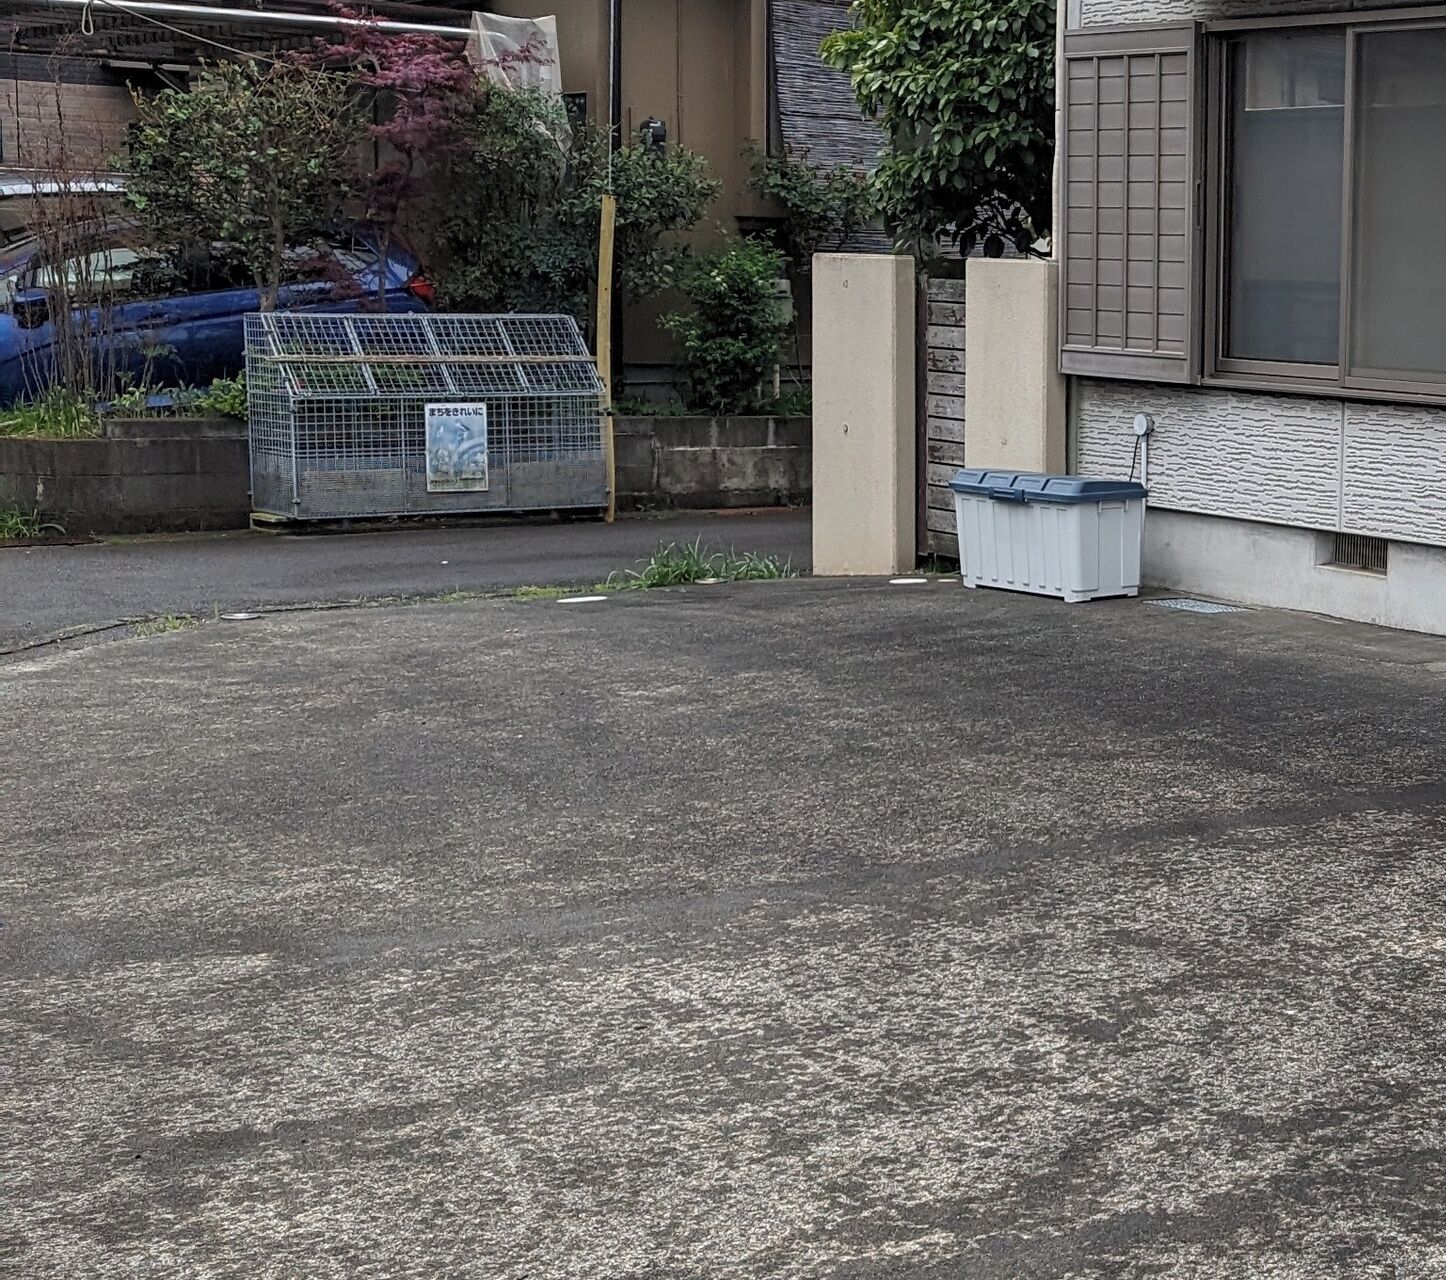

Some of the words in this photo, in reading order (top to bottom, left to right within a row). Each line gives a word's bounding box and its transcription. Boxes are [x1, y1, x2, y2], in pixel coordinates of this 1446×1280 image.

[428, 407, 483, 417] まちをきれいに
